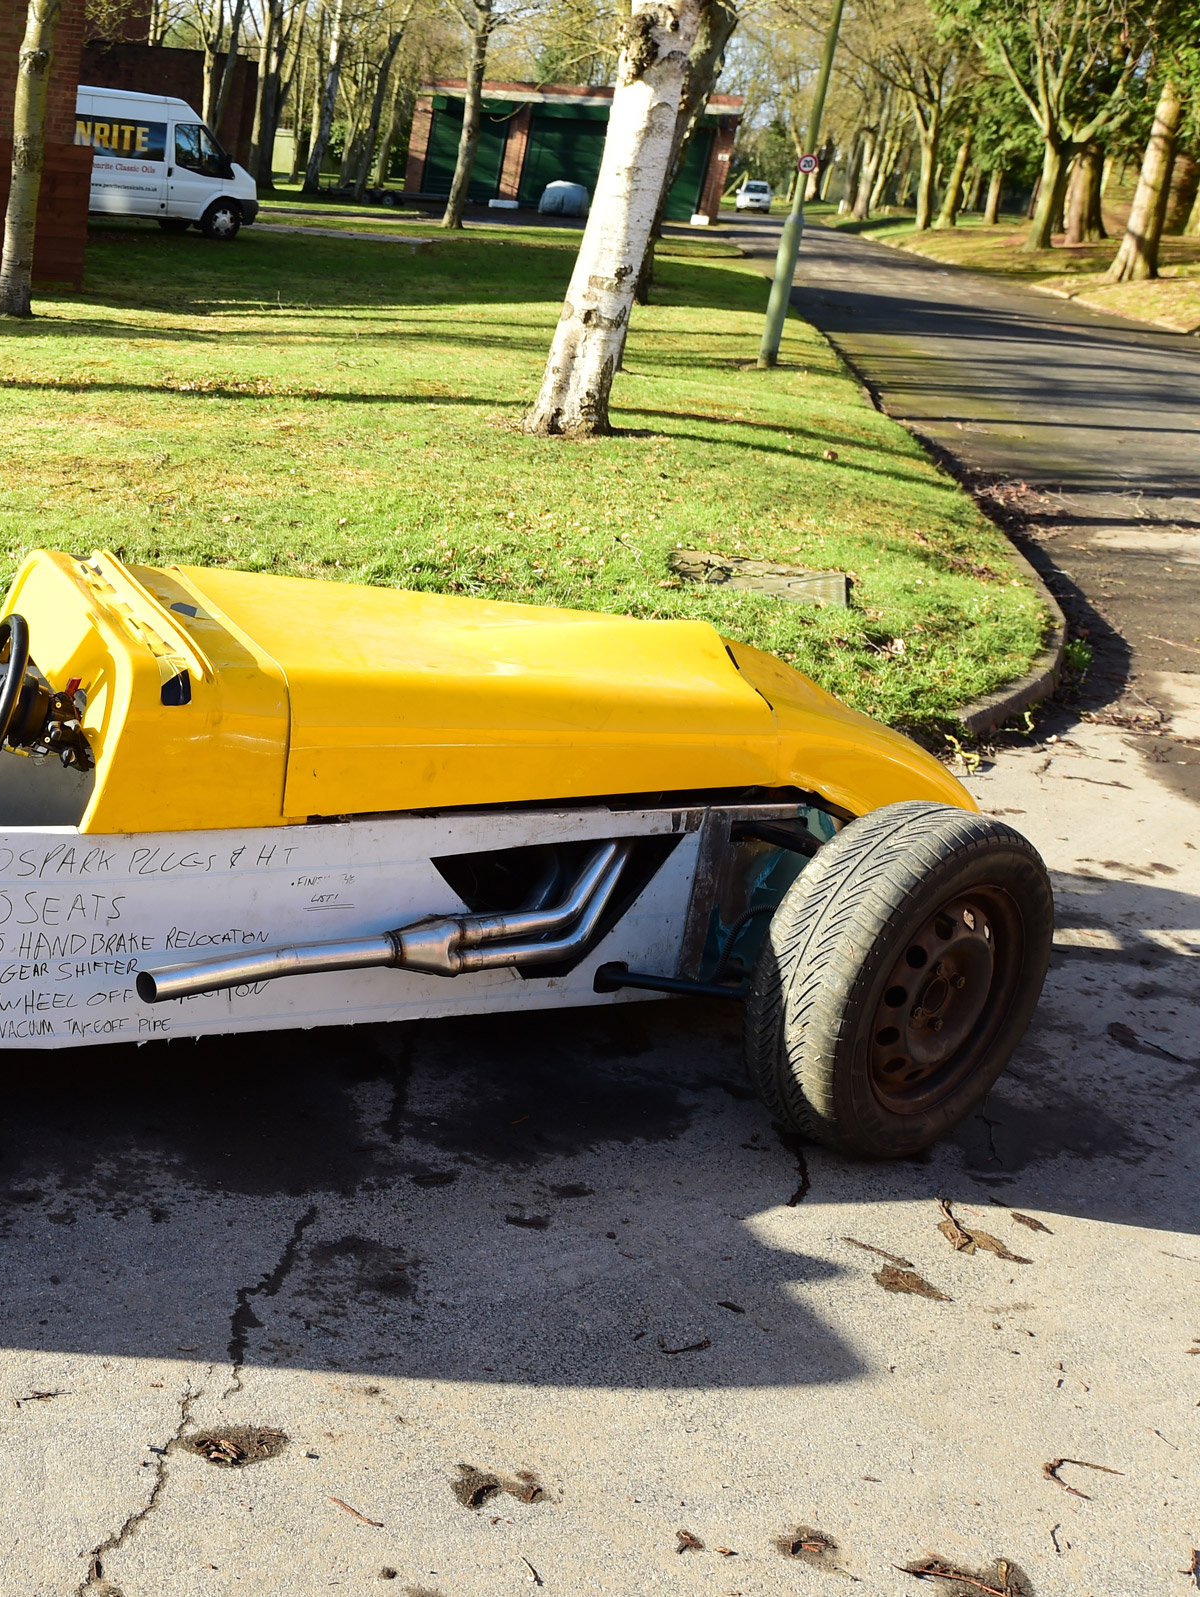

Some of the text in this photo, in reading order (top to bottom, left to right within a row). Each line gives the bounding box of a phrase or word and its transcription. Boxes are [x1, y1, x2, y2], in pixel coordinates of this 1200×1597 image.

[74, 120, 150, 152] NRITE
[115, 163, 139, 172] Classic
[141, 165, 156, 174] Oils
[802, 159, 814, 168] 20
[17, 843, 117, 878] SPARK
[16, 891, 126, 926] SEATS
[165, 926, 270, 951] RELOCATION
[0, 958, 141, 984] GEAR SHIFTER
[86, 989, 133, 1006] OFF
[138, 1017, 172, 1033] PIPE
